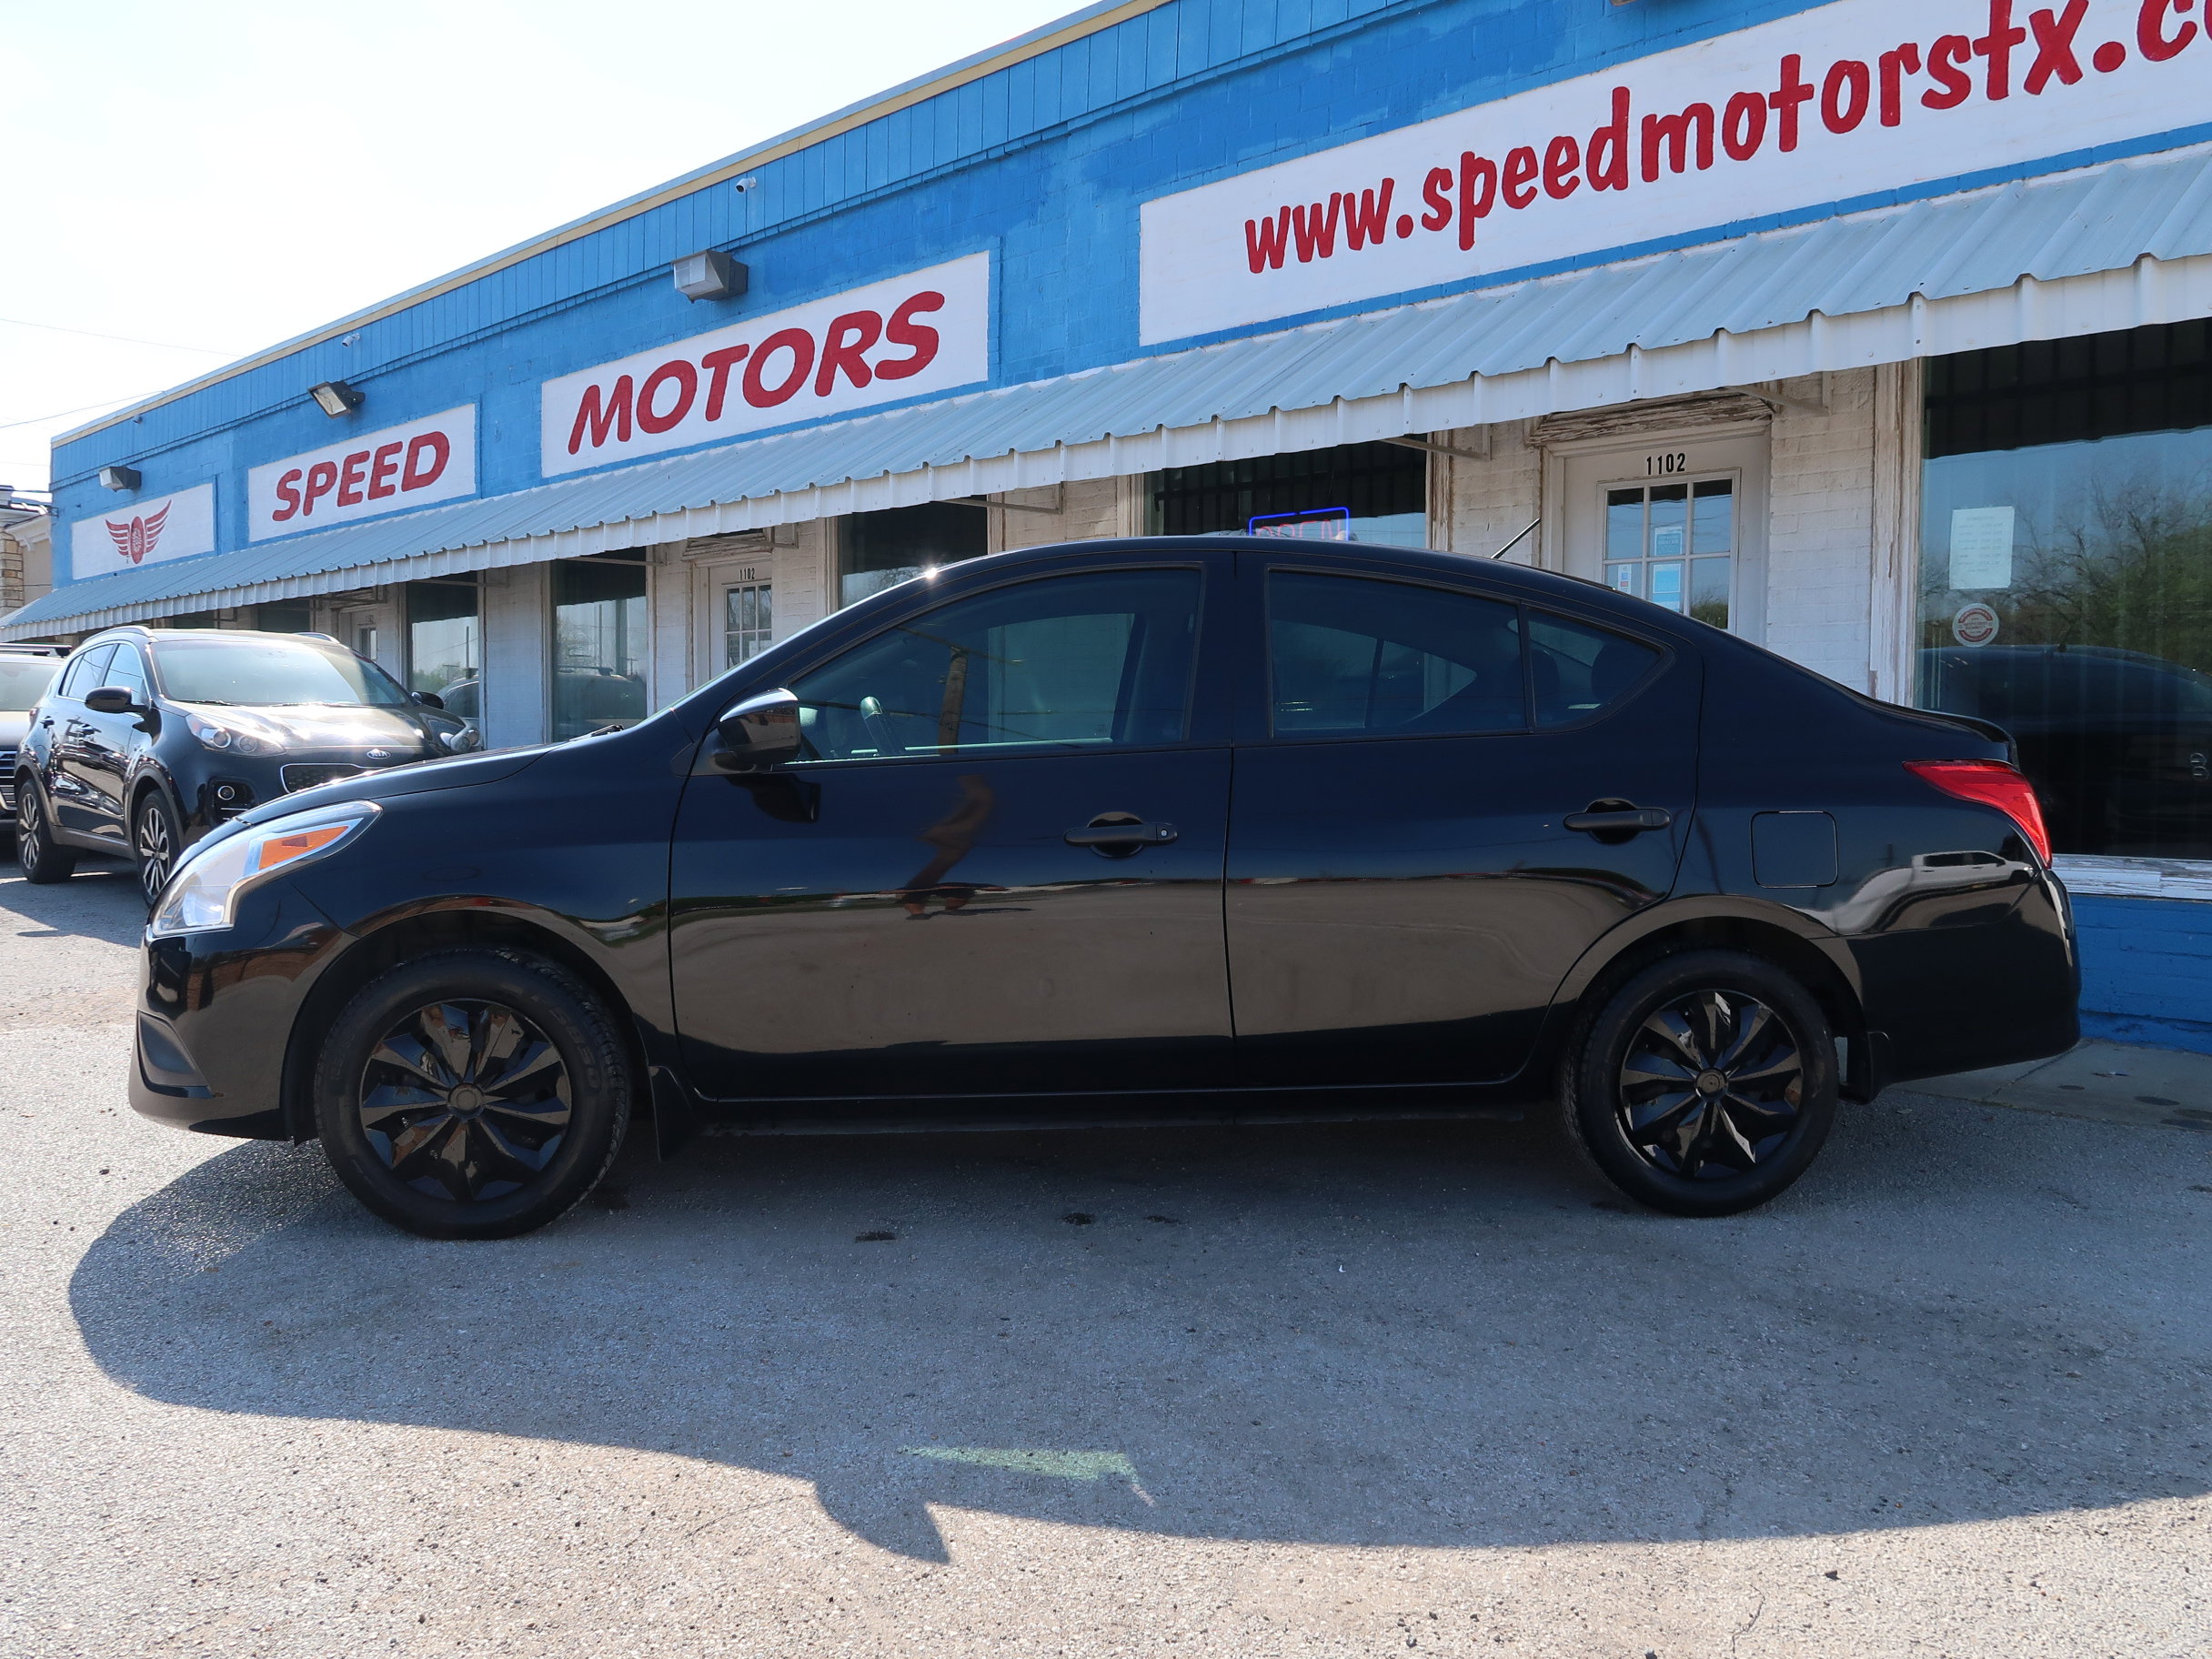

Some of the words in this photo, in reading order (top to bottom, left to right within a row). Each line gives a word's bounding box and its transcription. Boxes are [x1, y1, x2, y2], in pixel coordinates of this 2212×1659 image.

[1244, 0, 2212, 274] www.speedmotorstx.c
[568, 291, 945, 455] MOTORS
[272, 431, 450, 522] SPEED
[1646, 453, 1686, 476] 1102
[739, 568, 755, 580] 1102
